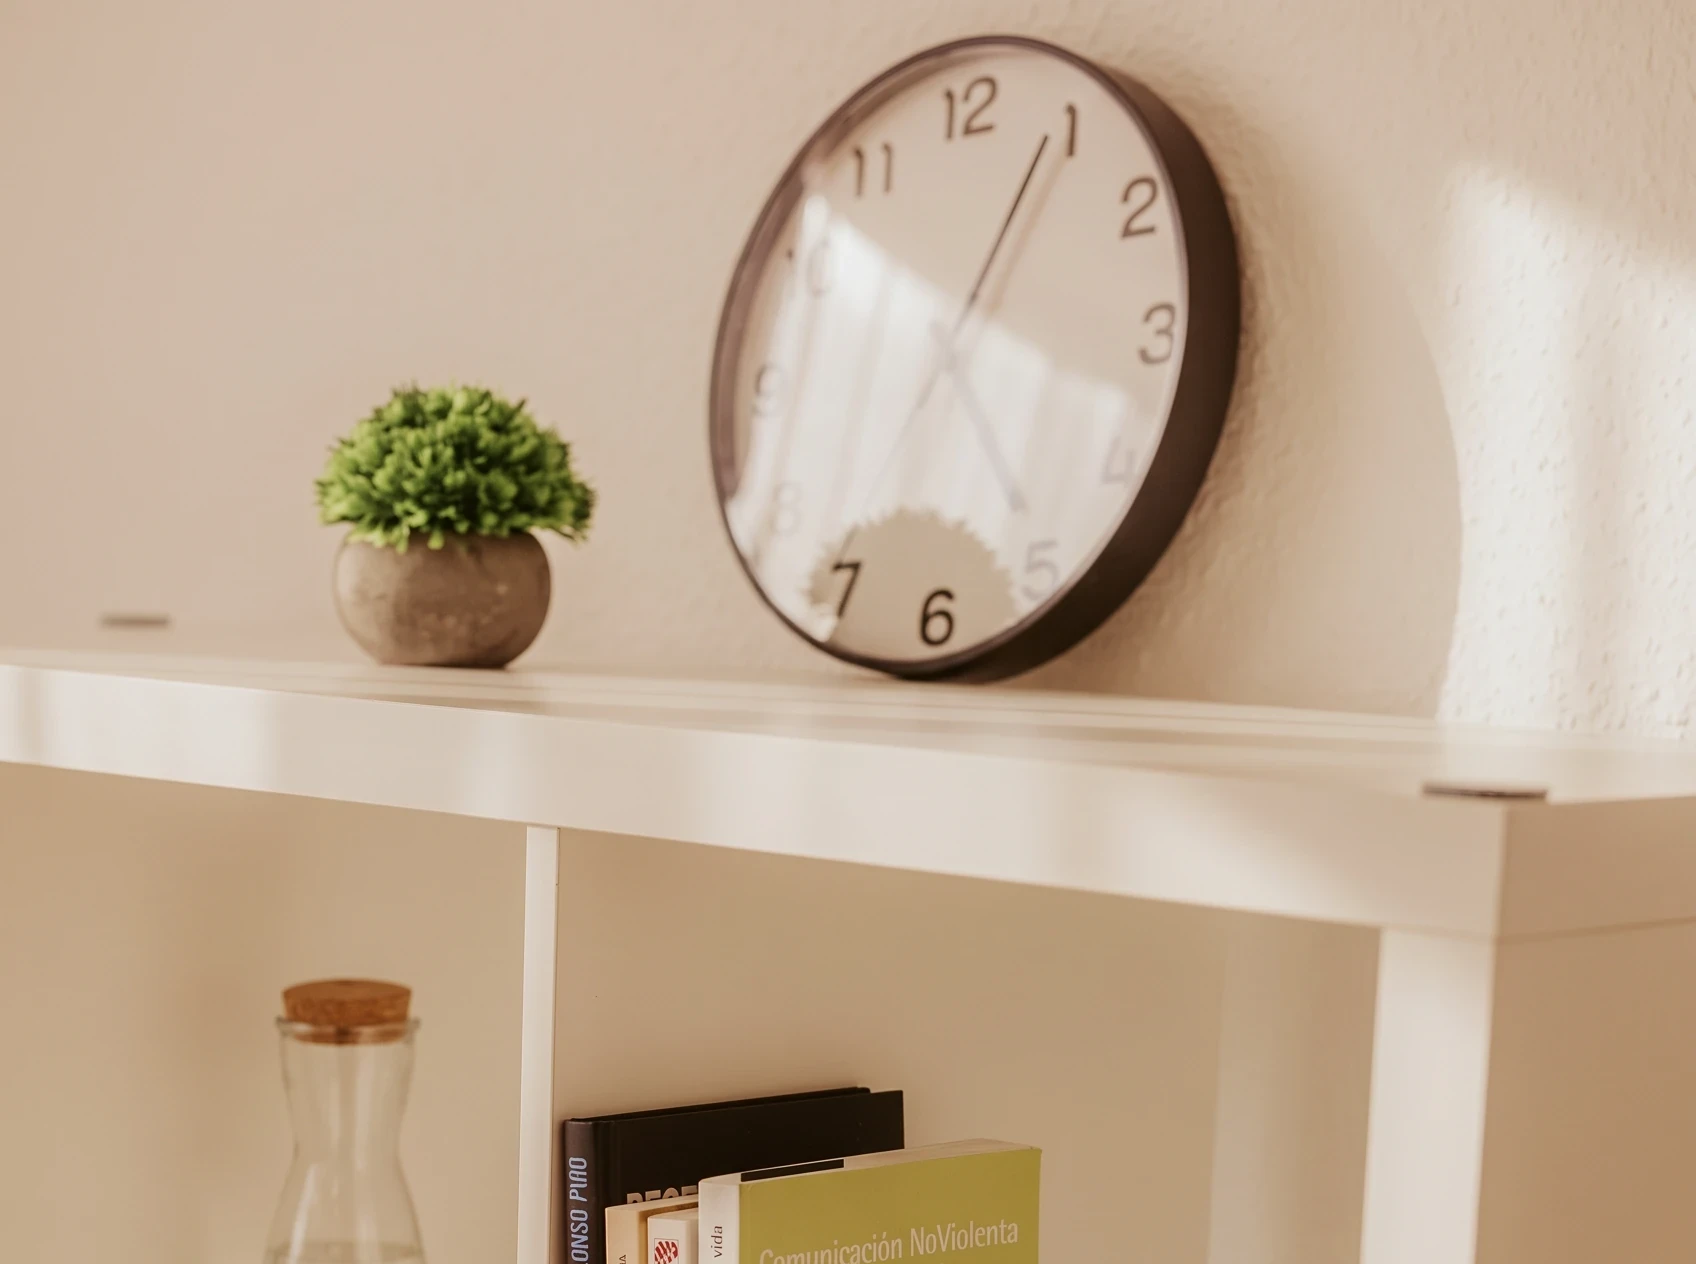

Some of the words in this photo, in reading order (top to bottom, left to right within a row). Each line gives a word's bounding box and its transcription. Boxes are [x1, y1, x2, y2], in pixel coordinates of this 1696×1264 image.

[943, 75, 999, 141] 12
[1064, 102, 1079, 158] 1
[852, 143, 895, 198] 11
[1121, 176, 1159, 239] 2
[1139, 302, 1175, 366] 3
[754, 363, 785, 418] 9
[1102, 437, 1137, 487] 4
[831, 561, 861, 620] 7
[1022, 541, 1061, 601] 5
[919, 589, 956, 647] 6
[710, 1225, 723, 1258] vida
[910, 1218, 1019, 1257] NoViolenta
